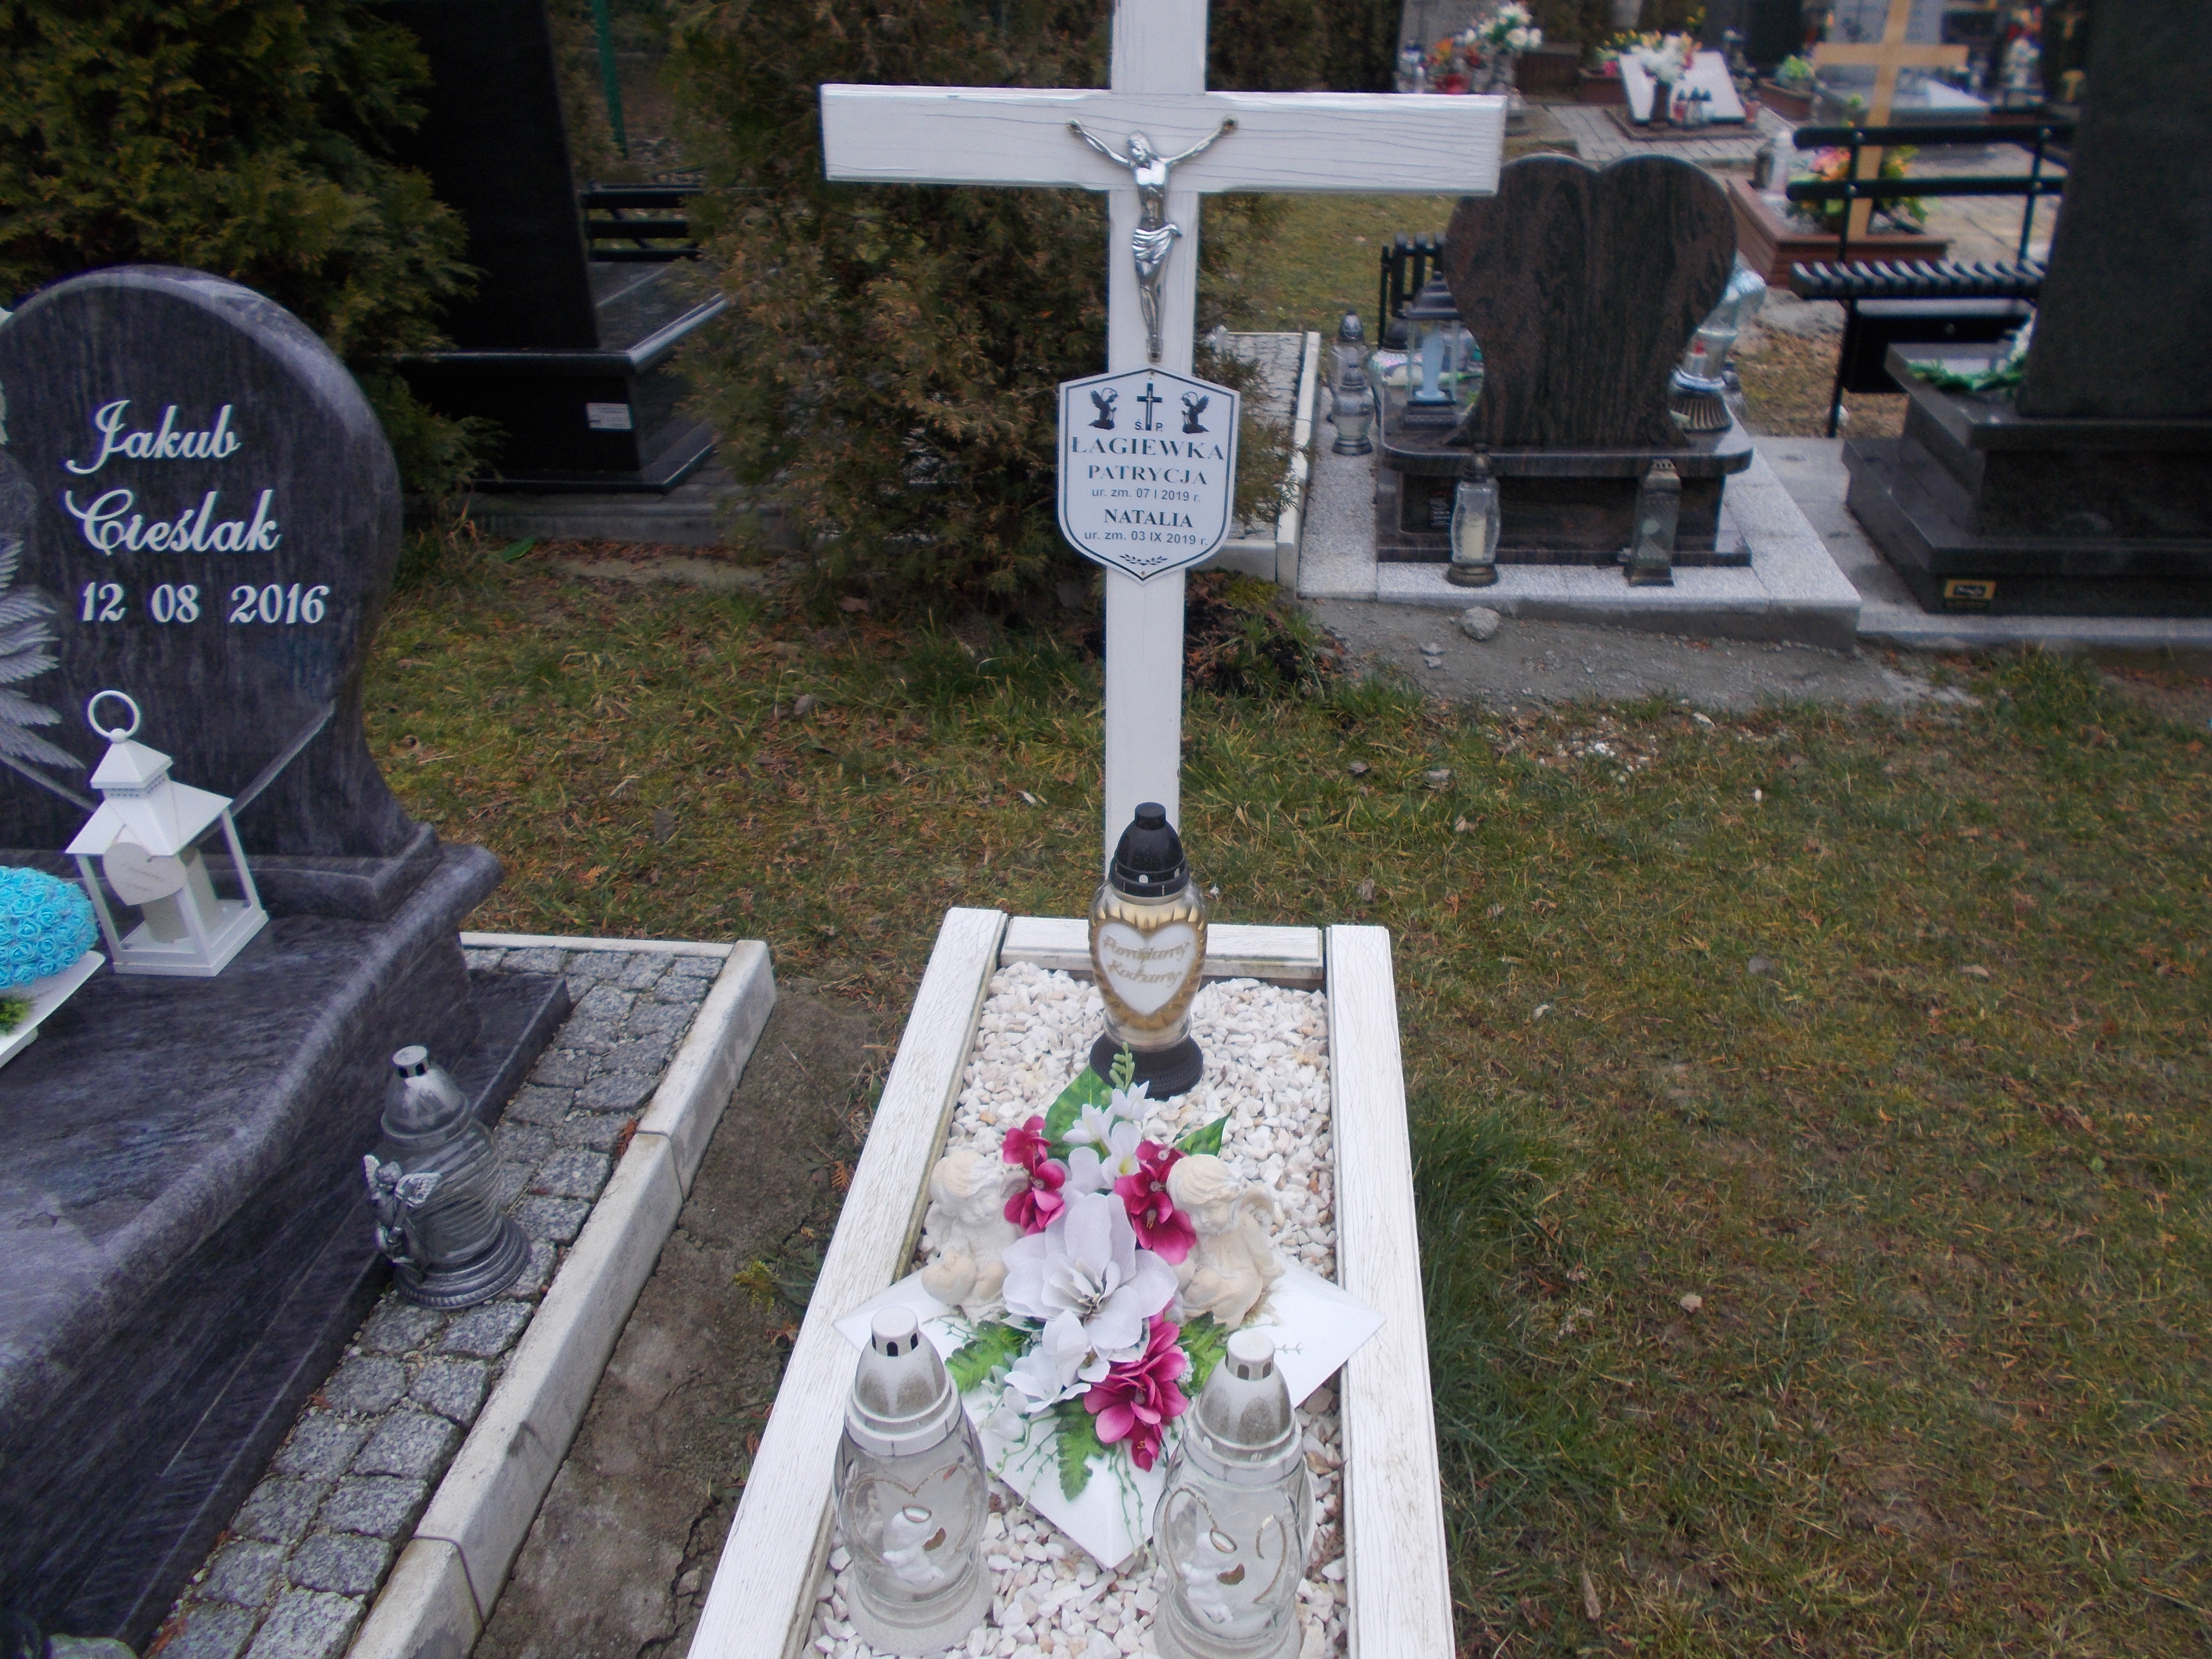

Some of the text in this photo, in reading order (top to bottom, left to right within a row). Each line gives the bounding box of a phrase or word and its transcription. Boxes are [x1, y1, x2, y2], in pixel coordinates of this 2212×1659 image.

[66, 399, 241, 474] Jakub
[1088, 465, 1207, 485] PATRYCJA
[1111, 489, 1131, 497] zm.
[1136, 488, 1150, 498] 07
[1161, 490, 1190, 501] 2019
[65, 489, 282, 556] Cieślak
[1104, 509, 1193, 528] NATALIA
[1084, 531, 1208, 546] ur. zm. 03 IX 2019 r.
[82, 581, 331, 625] 12 08 2016
